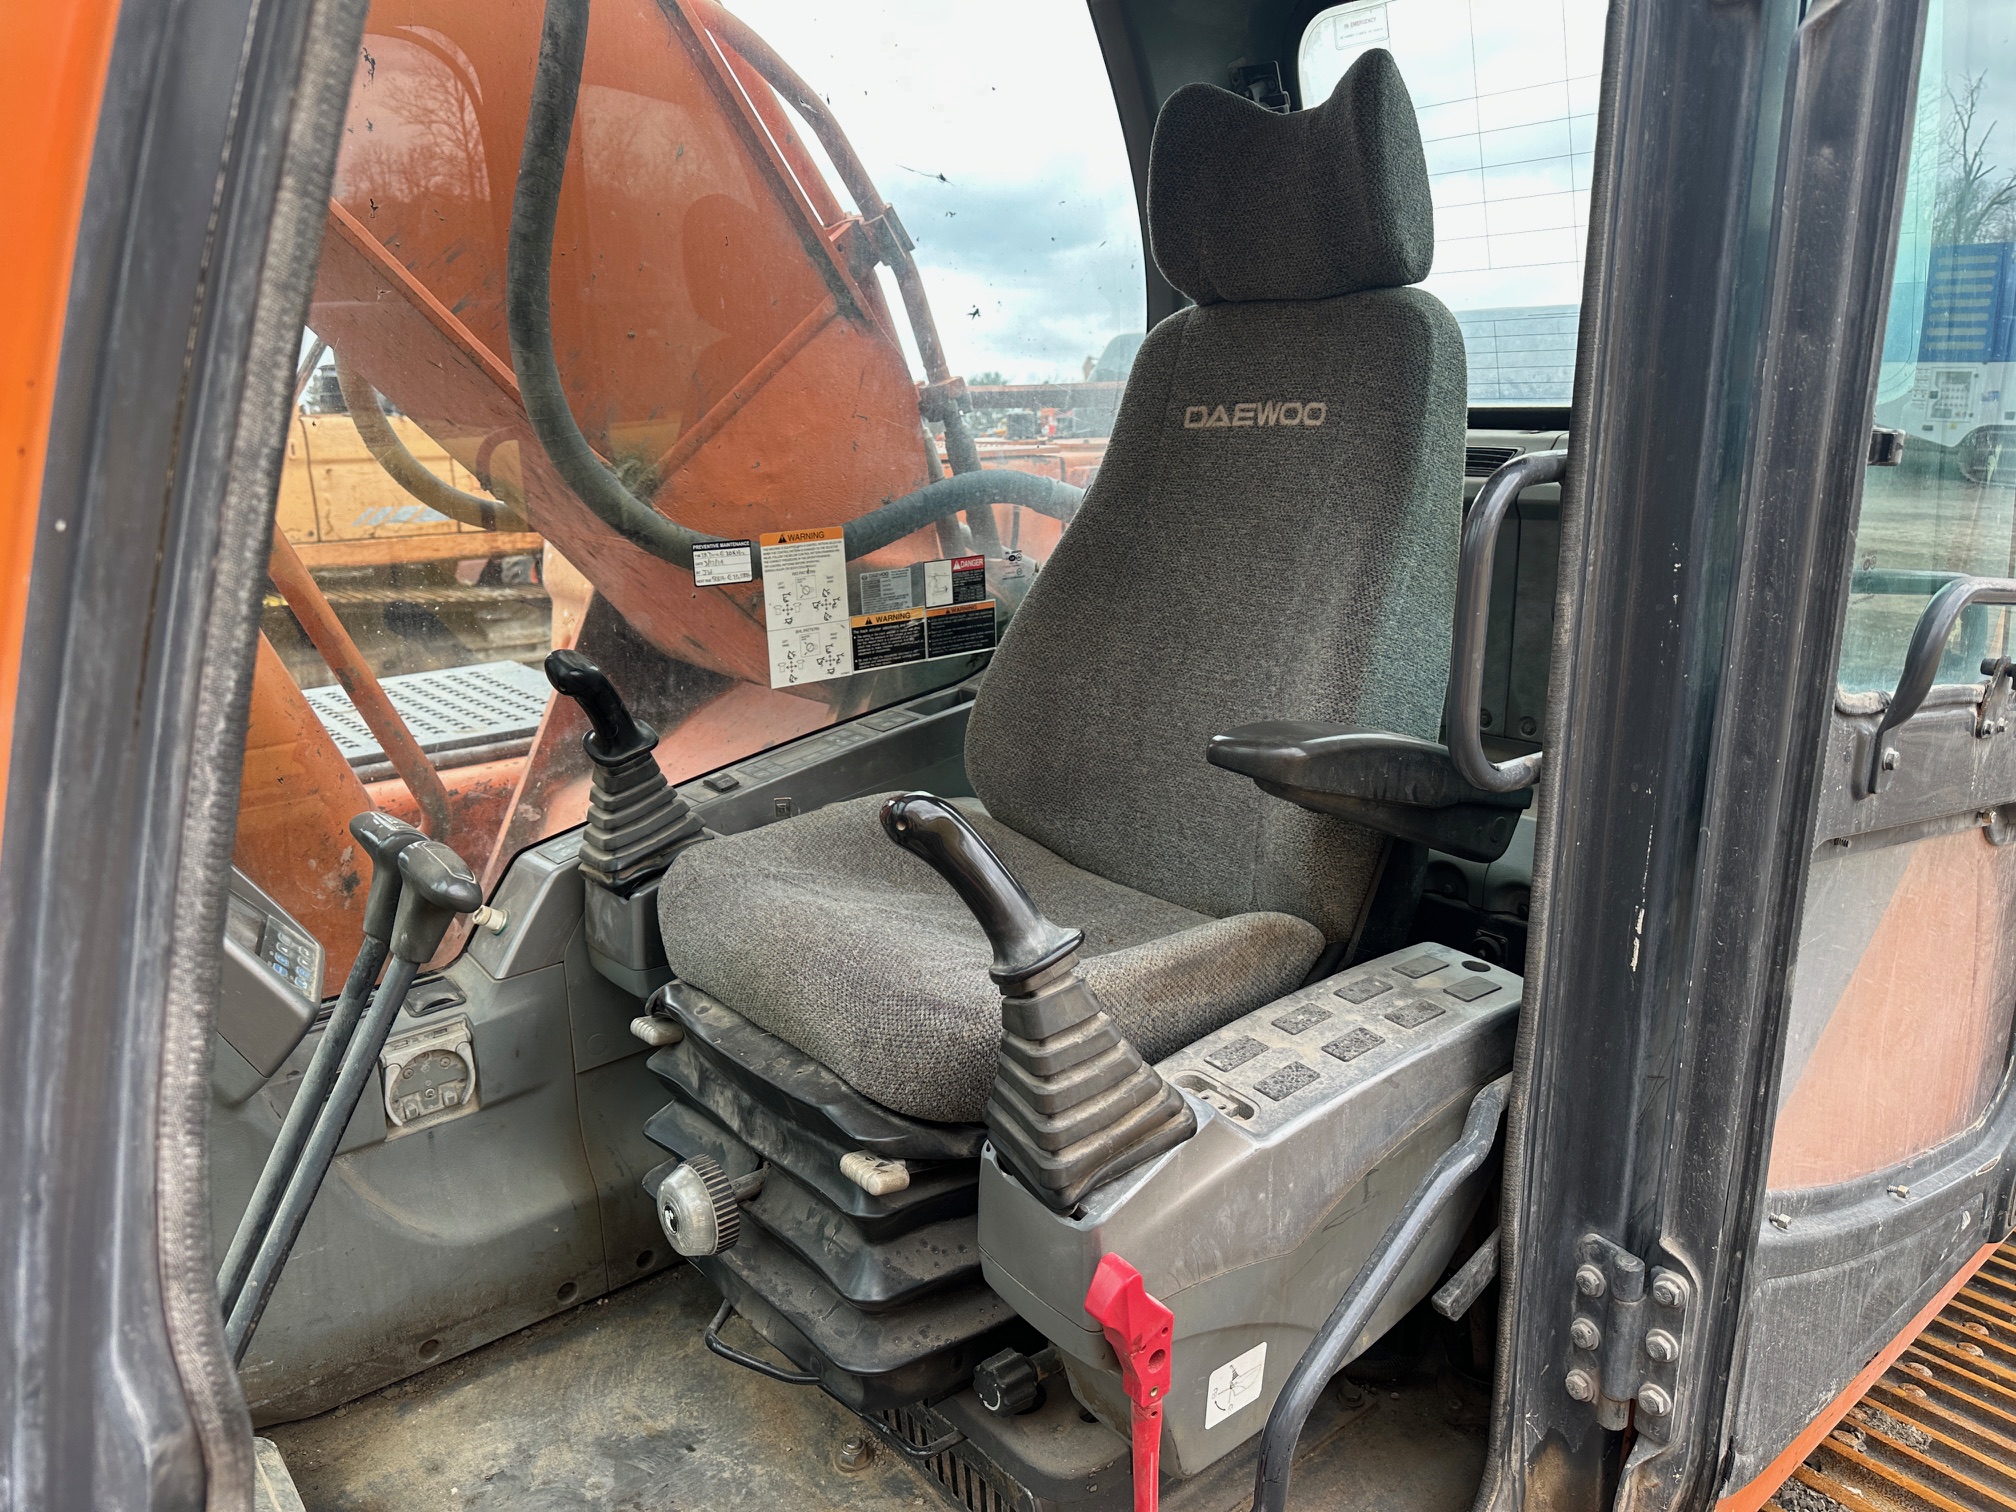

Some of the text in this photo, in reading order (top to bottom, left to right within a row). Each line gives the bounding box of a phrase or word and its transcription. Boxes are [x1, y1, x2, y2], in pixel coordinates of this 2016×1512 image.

[1183, 401, 1327, 428] DAEWOO
[787, 531, 824, 542] WARNING
[960, 558, 983, 568] DANGER
[950, 604, 977, 613] WARNING
[876, 612, 911, 623] WARNING
